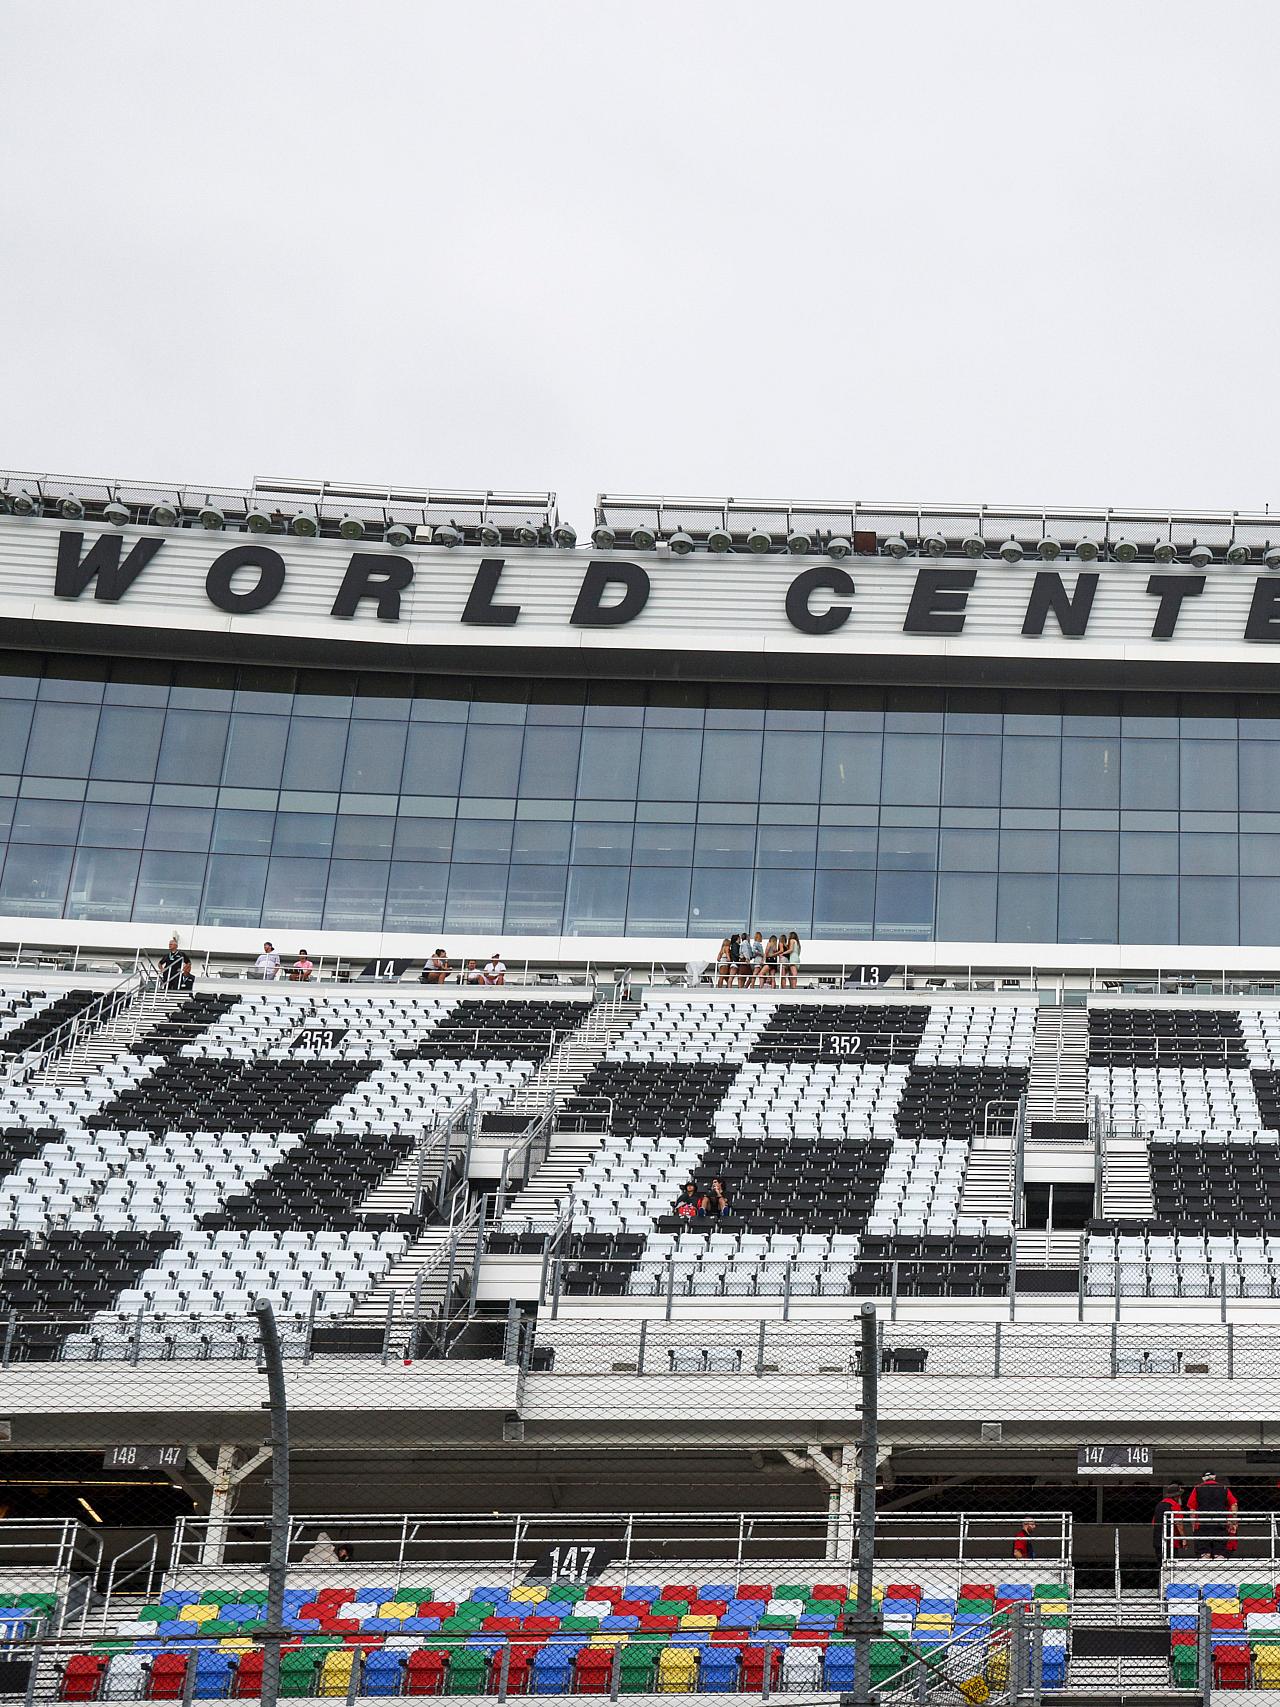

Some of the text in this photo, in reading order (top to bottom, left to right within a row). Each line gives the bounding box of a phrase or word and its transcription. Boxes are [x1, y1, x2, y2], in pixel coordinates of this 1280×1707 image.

[54, 531, 651, 627] WORLD
[374, 960, 395, 980] L4
[860, 966, 880, 986] L3
[300, 1030, 333, 1050] 353
[829, 1035, 861, 1055] 352
[112, 1447, 181, 1465] 148 147
[1084, 1447, 1149, 1463] 147 146
[549, 1546, 596, 1584] 147
